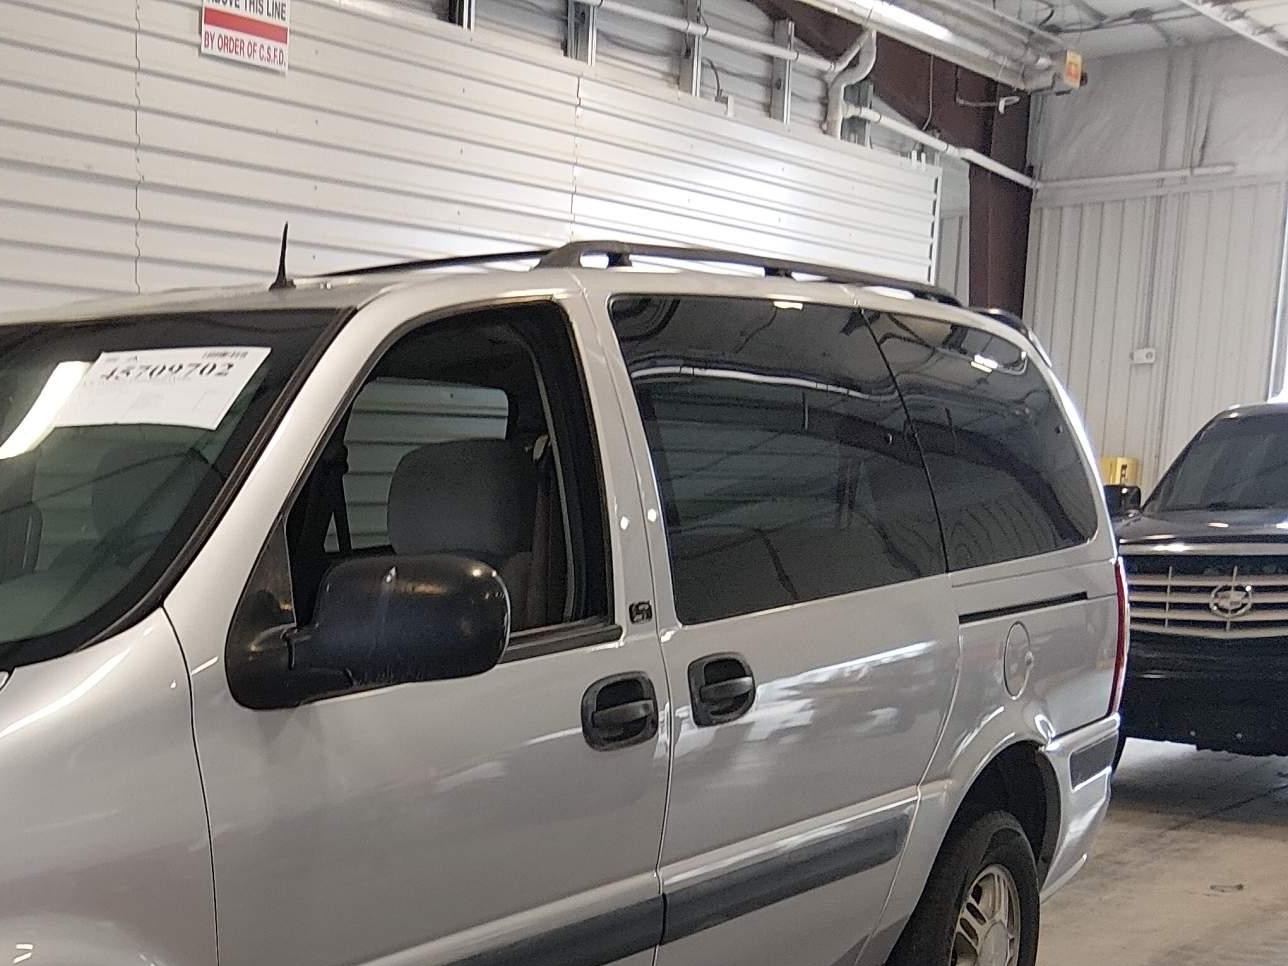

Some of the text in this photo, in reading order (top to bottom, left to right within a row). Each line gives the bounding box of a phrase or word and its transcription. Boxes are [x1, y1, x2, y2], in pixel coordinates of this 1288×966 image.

[244, 0, 264, 15] THIS
[266, 0, 287, 20] LINE
[204, 31, 286, 66] BY ORDER OF C.S.F.D.
